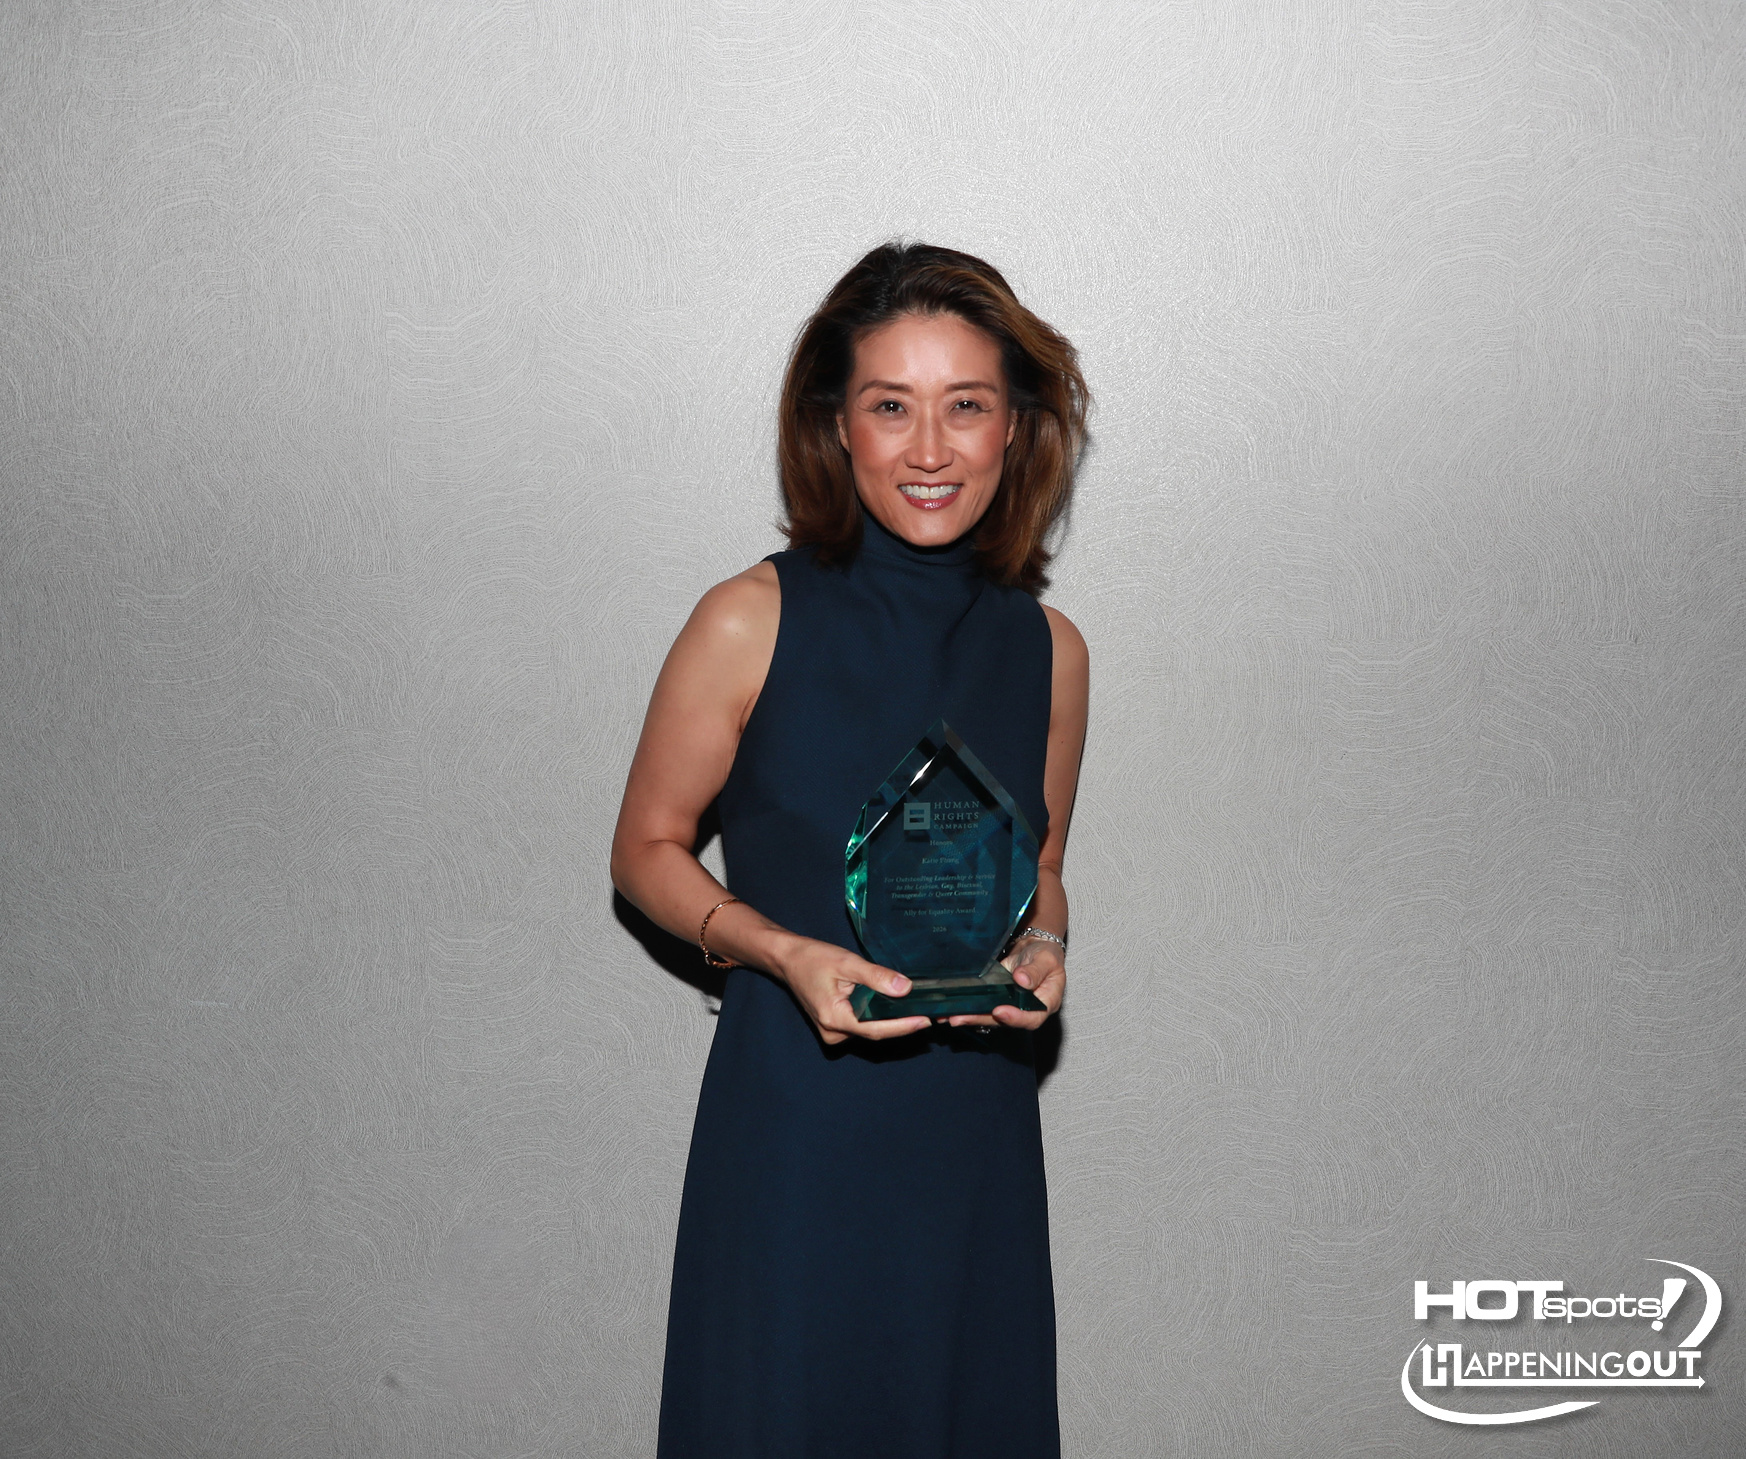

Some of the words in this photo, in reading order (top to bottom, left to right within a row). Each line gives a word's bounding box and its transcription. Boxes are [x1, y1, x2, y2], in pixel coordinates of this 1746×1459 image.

[934, 801, 980, 809] HUMAN
[934, 812, 980, 820] RIGHTS
[934, 874, 967, 882] Leadership
[891, 892, 927, 900] Transgender
[903, 909, 917, 917] Ally
[928, 907, 954, 917] Equality
